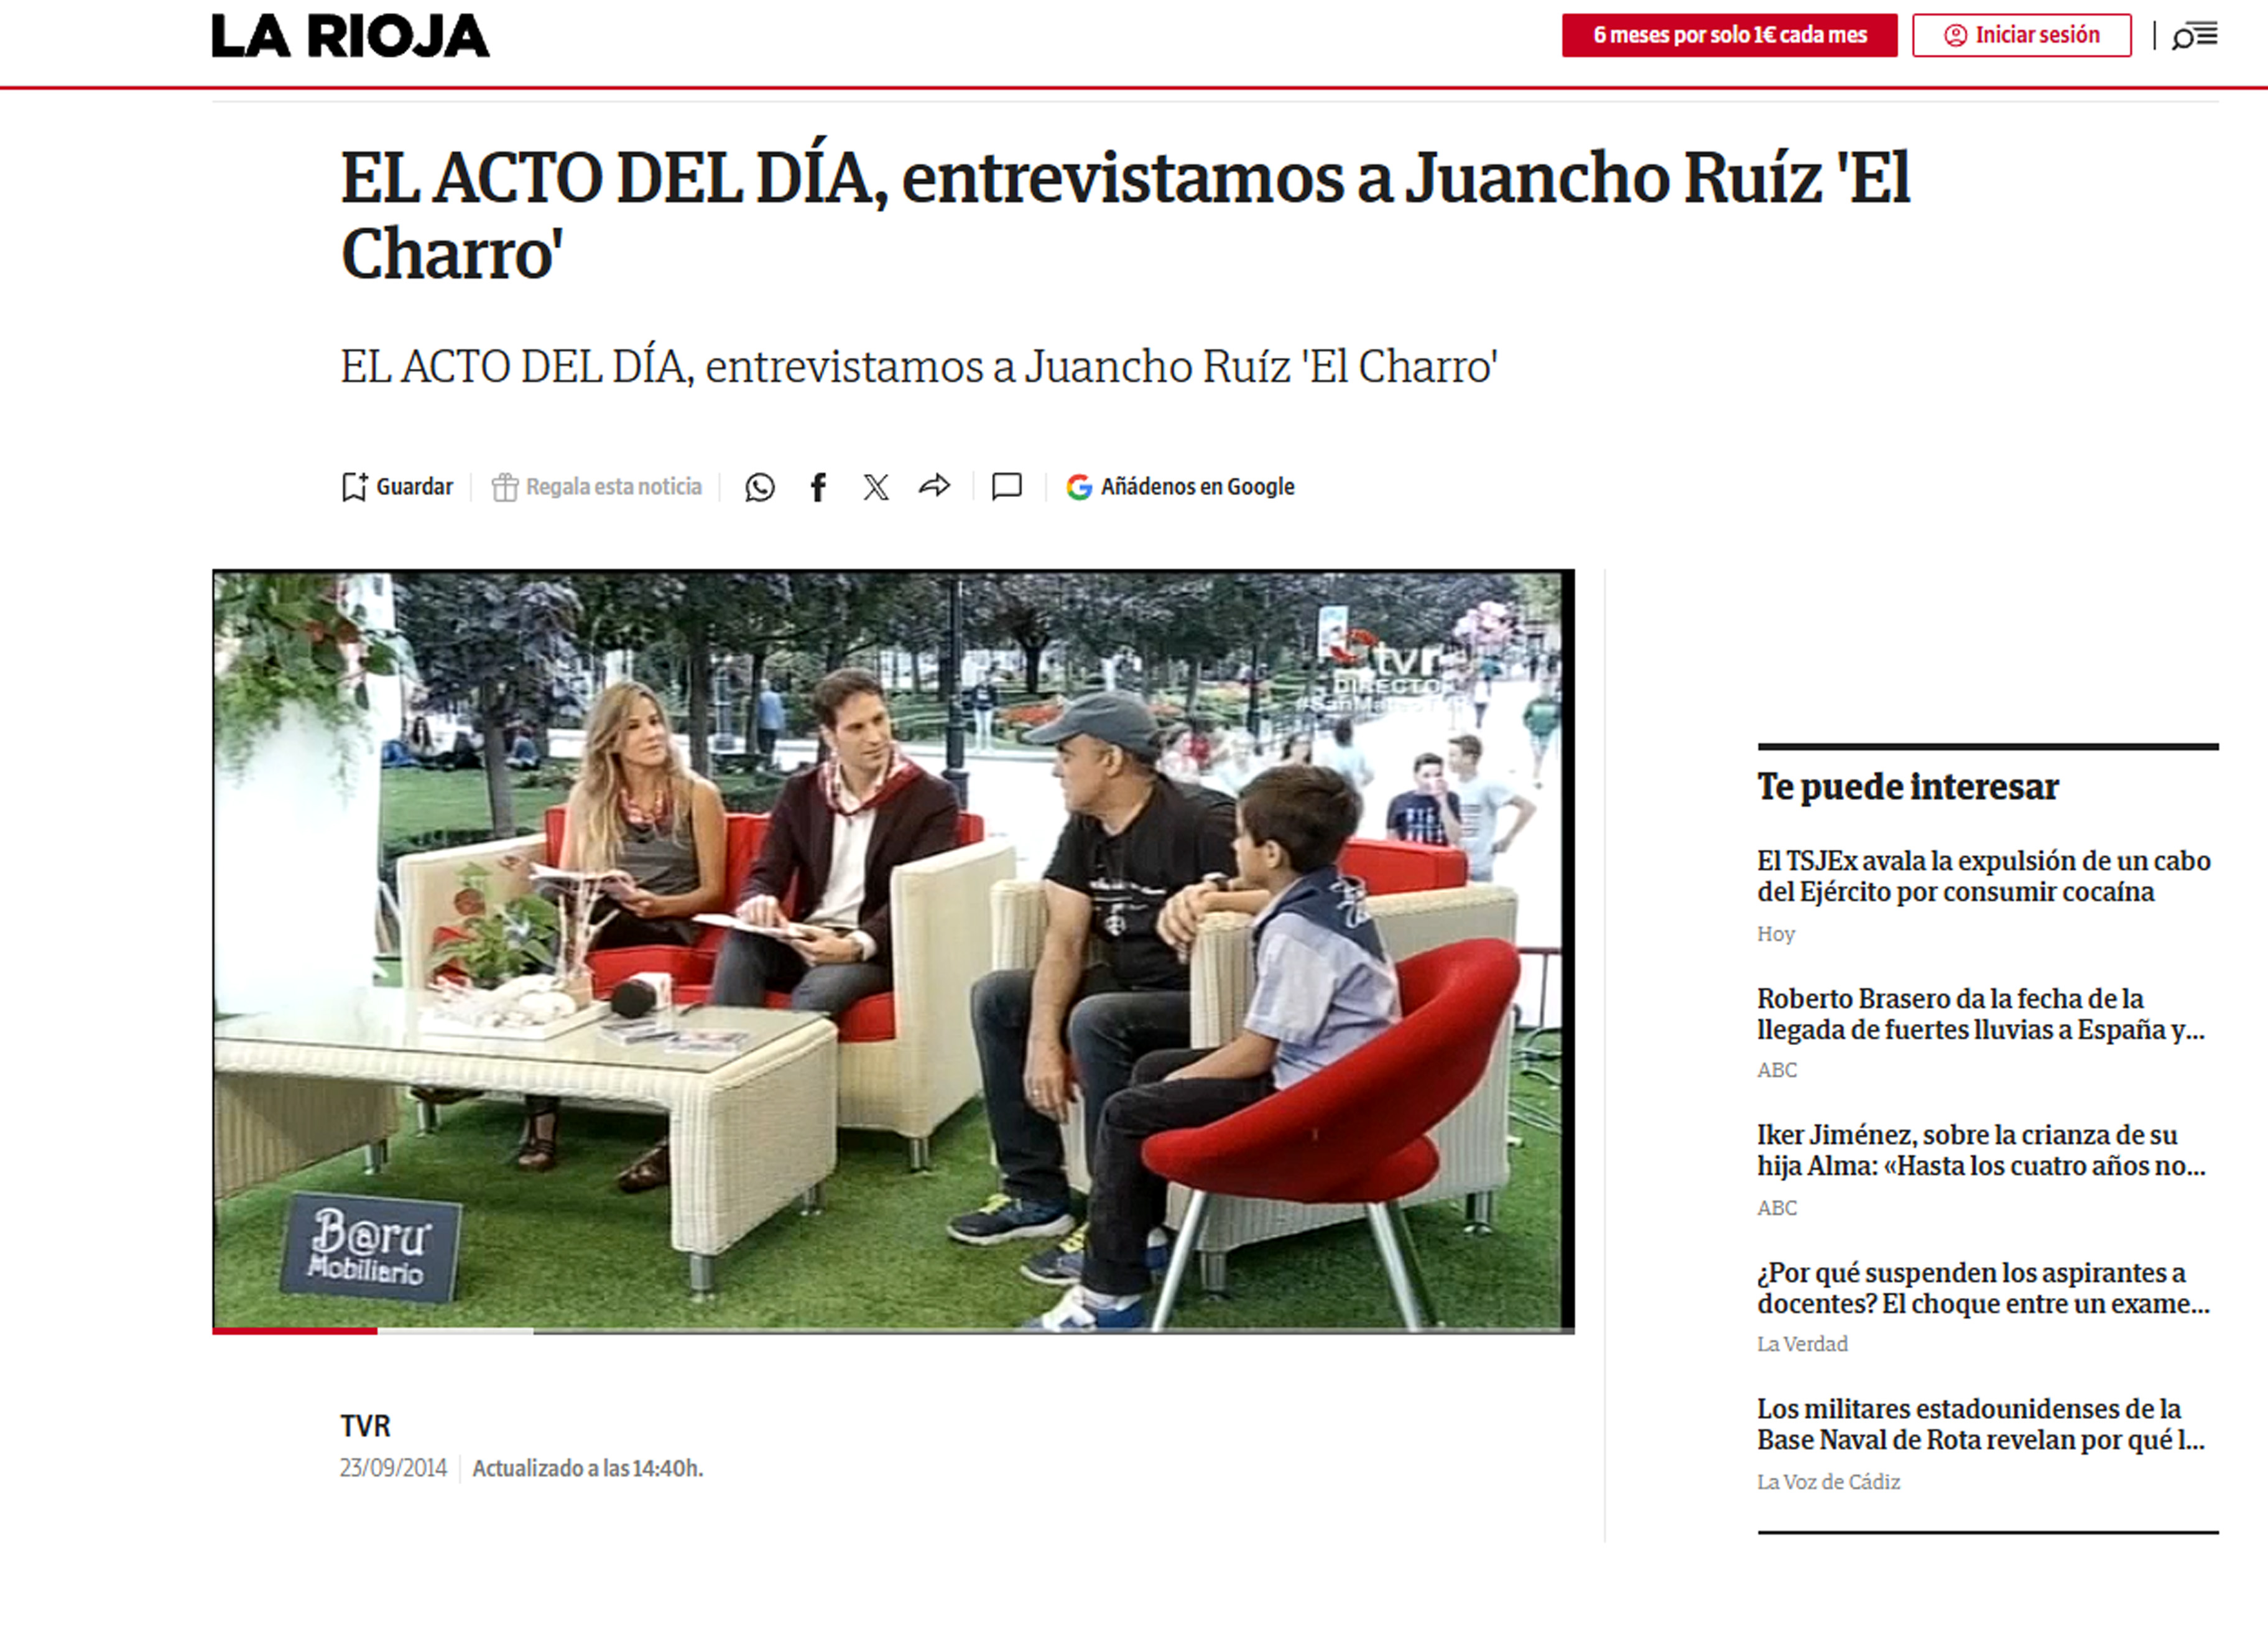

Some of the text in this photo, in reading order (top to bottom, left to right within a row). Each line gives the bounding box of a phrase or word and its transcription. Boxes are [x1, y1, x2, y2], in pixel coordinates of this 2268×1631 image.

[212, 13, 490, 58] LA RIOJA
[1593, 24, 1868, 47] 6 meses por solo 1€ cada mes
[1976, 24, 2100, 43] Iniciar sesión
[341, 135, 1911, 212] EL ACTO DEL DÍA, entrevistamos a Juancho Ruíz 'El
[343, 224, 563, 279] Charro'
[341, 340, 1497, 388] EL ACTO DEL DÍA, entrevistamos a Juancho Ruíz 'El Charro'
[376, 476, 454, 495] Guardar
[527, 476, 702, 498] Regala esta noticia
[1101, 476, 1295, 499] Añádenos en Google
[1757, 771, 2060, 807] Te puede interesar
[1758, 848, 2211, 876] El TSJEx avala la expulsión de un cabo
[1758, 879, 2156, 907] del Ejército por consumir cocaína
[1757, 926, 1796, 945] Hoy
[1758, 987, 2145, 1009] Roberto Brasero da la fecha de la
[1758, 1018, 2205, 1045] llegada de fuertes lluvias a España y...
[1757, 1062, 1797, 1077] ABC
[1758, 1122, 2178, 1148] Iker Jiménez, sobre la crianza de su
[1758, 1155, 2206, 1181] hija Alma: «Hasta los cuatro años no...
[1757, 1200, 1797, 1215] ABC
[307, 1253, 424, 1286] Mobiliario
[1758, 1260, 2187, 1288] ¿Por qué suspenden los aspirantes a
[1758, 1292, 2210, 1319] docentes? El choque entre un exame...
[1757, 1335, 1849, 1352] La Verdad
[1758, 1397, 2182, 1419] Los militares estadounidenses de la
[340, 1415, 391, 1437] TVR
[1758, 1427, 2205, 1455] Base Naval de Rota revelan por qué l...
[340, 1458, 448, 1477] 23/09/2014
[471, 1458, 704, 1477] Actualizado a las 14:40h.
[1757, 1472, 1901, 1490] La Voz de Cádiz
